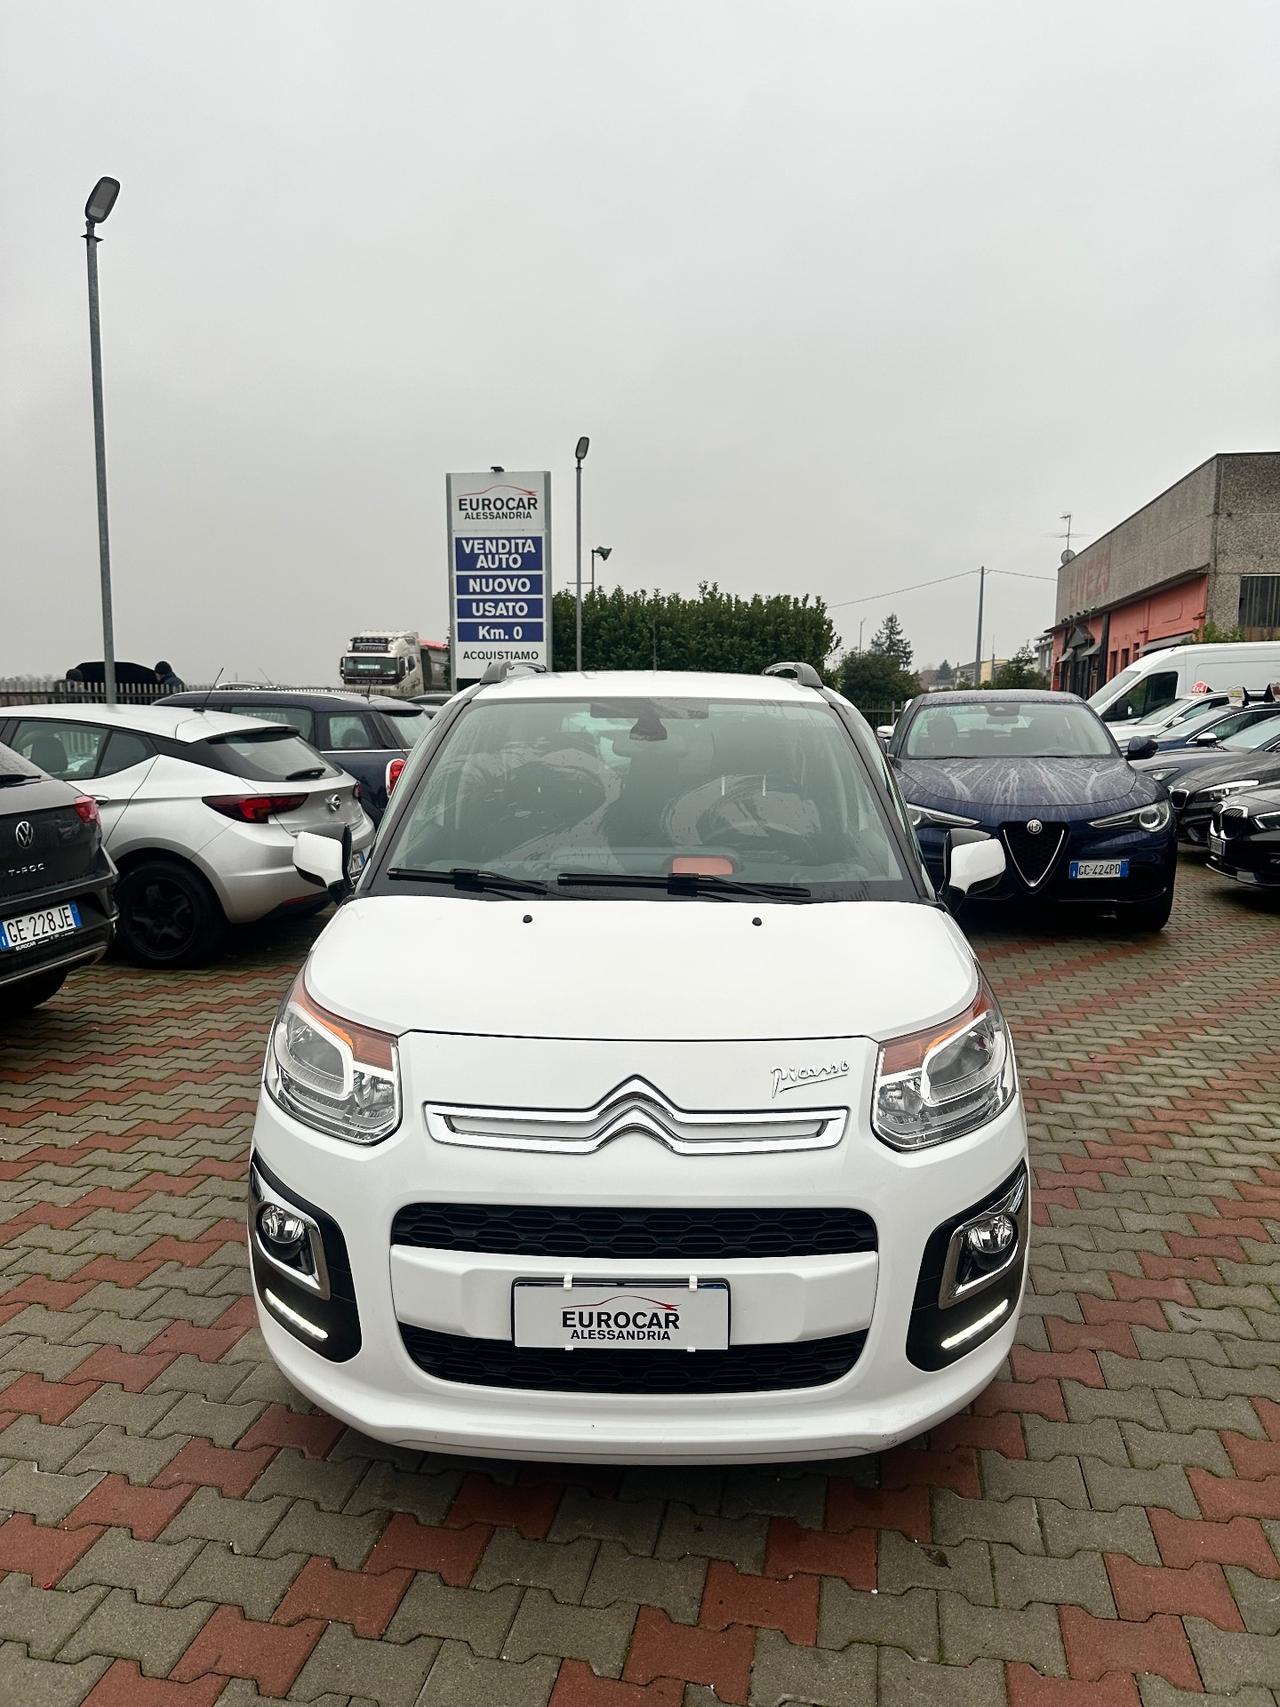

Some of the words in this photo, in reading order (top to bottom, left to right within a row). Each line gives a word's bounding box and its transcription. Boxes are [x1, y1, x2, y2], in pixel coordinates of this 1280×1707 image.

[458, 497, 538, 512] EUROCAR
[464, 511, 533, 520] ALESSANDRIA
[462, 539, 536, 554] VENDITA
[476, 554, 522, 569] AUTO
[468, 578, 531, 593] NUOVO
[472, 601, 528, 616] USATO
[478, 625, 509, 640] Km.
[513, 626, 523, 640] 0
[462, 651, 539, 661] ACQUISTIAMO
[561, 1310, 680, 1330] EUROCAR
[570, 1329, 672, 1341] ALESSANDRIA
